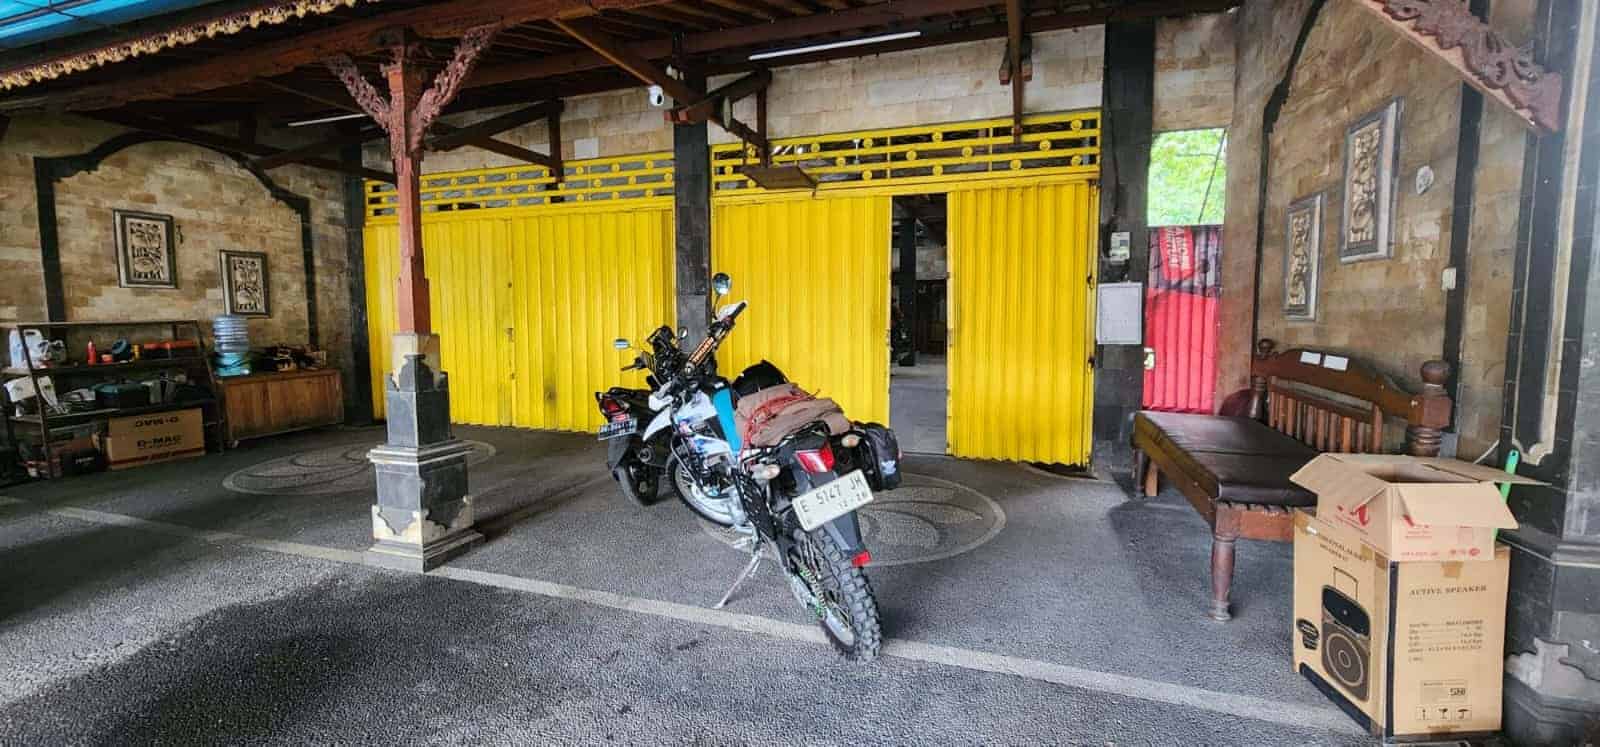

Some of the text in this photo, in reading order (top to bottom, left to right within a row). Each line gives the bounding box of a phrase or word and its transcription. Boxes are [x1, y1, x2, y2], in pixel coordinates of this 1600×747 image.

[800, 499, 809, 513] E
[815, 484, 842, 504] 5147
[1410, 584, 1487, 597] ACTIVE SPEAKER
